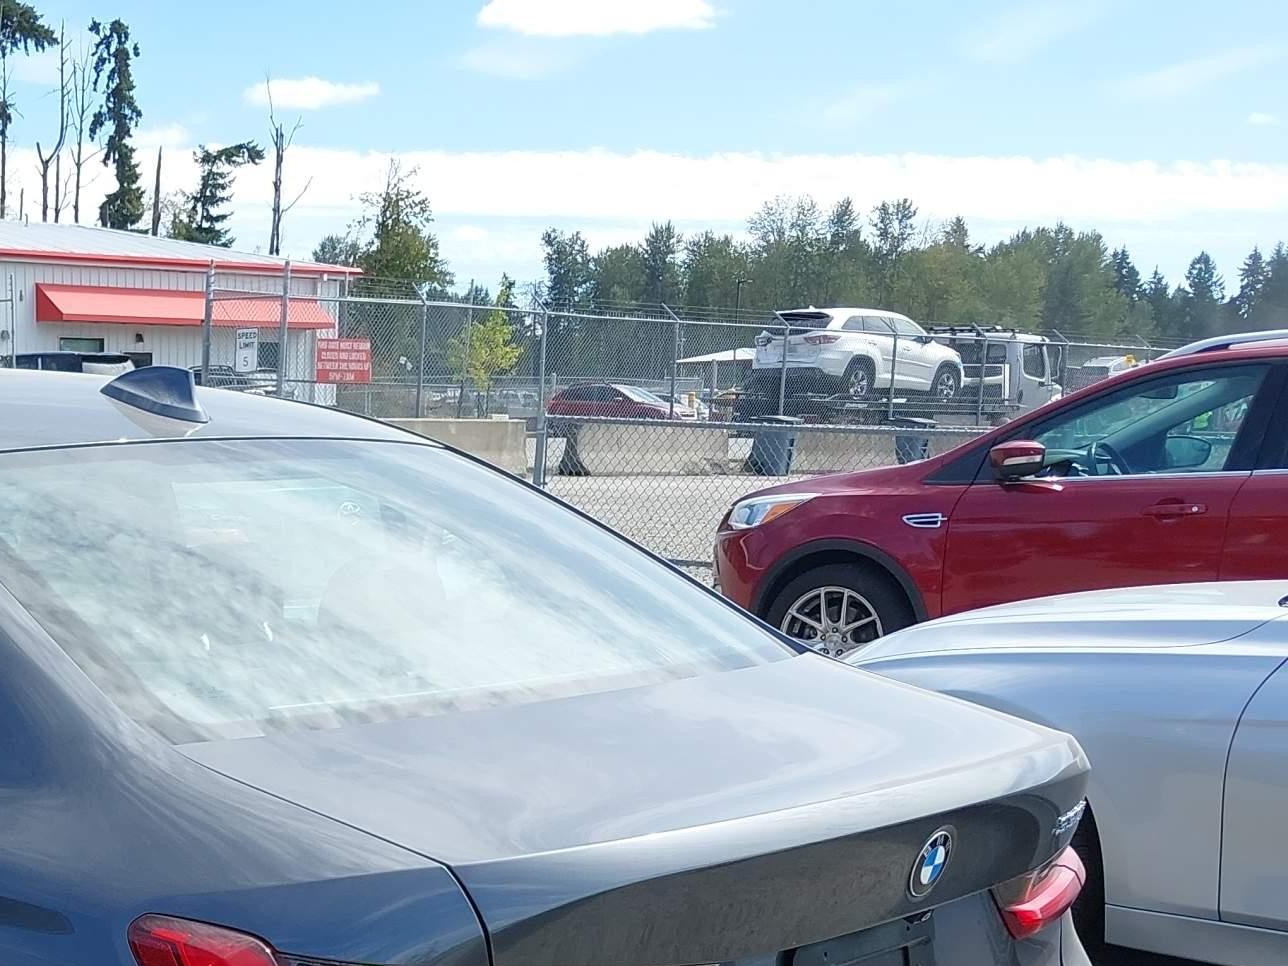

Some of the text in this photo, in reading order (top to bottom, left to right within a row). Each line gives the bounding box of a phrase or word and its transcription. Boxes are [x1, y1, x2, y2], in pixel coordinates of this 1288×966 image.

[237, 331, 257, 339] SPEED
[239, 341, 256, 349] LIMIT
[242, 356, 249, 367] 5
